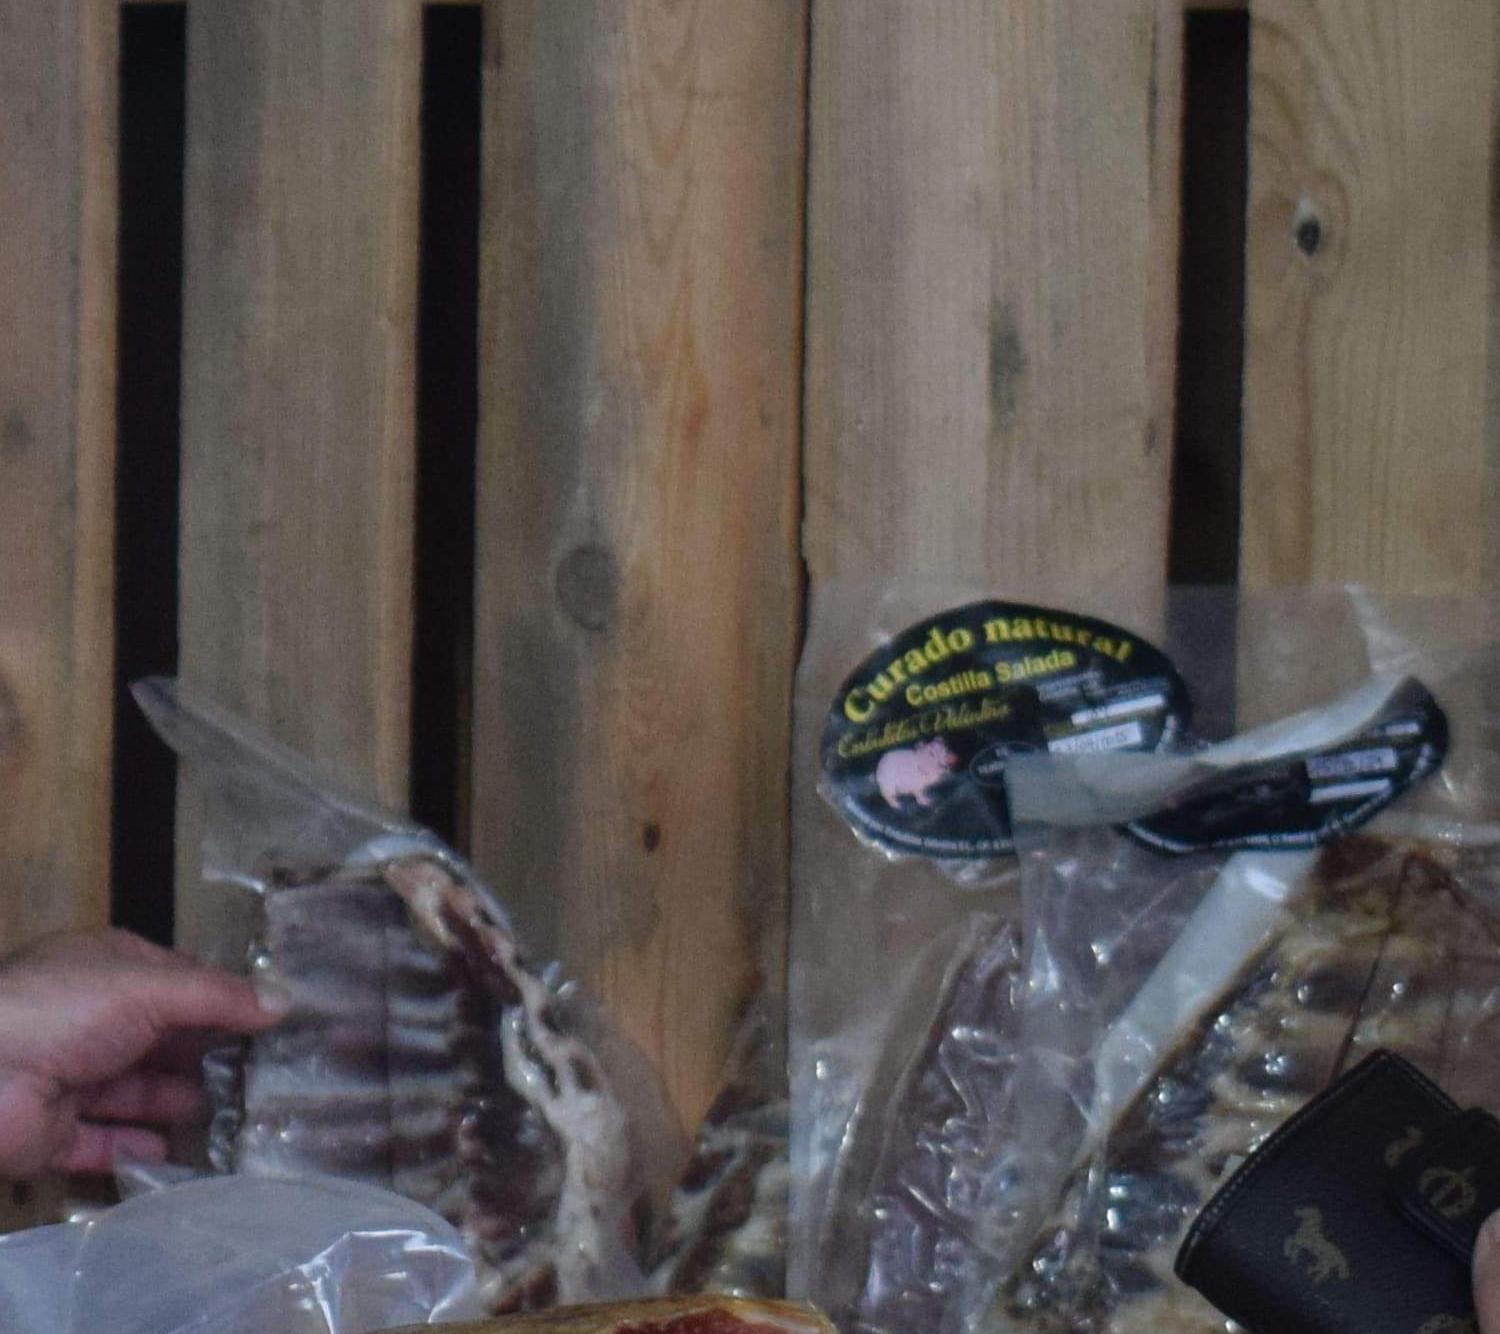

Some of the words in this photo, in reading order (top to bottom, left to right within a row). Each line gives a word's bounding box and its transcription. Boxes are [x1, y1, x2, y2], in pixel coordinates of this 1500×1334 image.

[844, 626, 975, 724] Curado
[982, 616, 1135, 664] natural
[905, 669, 994, 707] Costilla
[994, 648, 1078, 684] Salada
